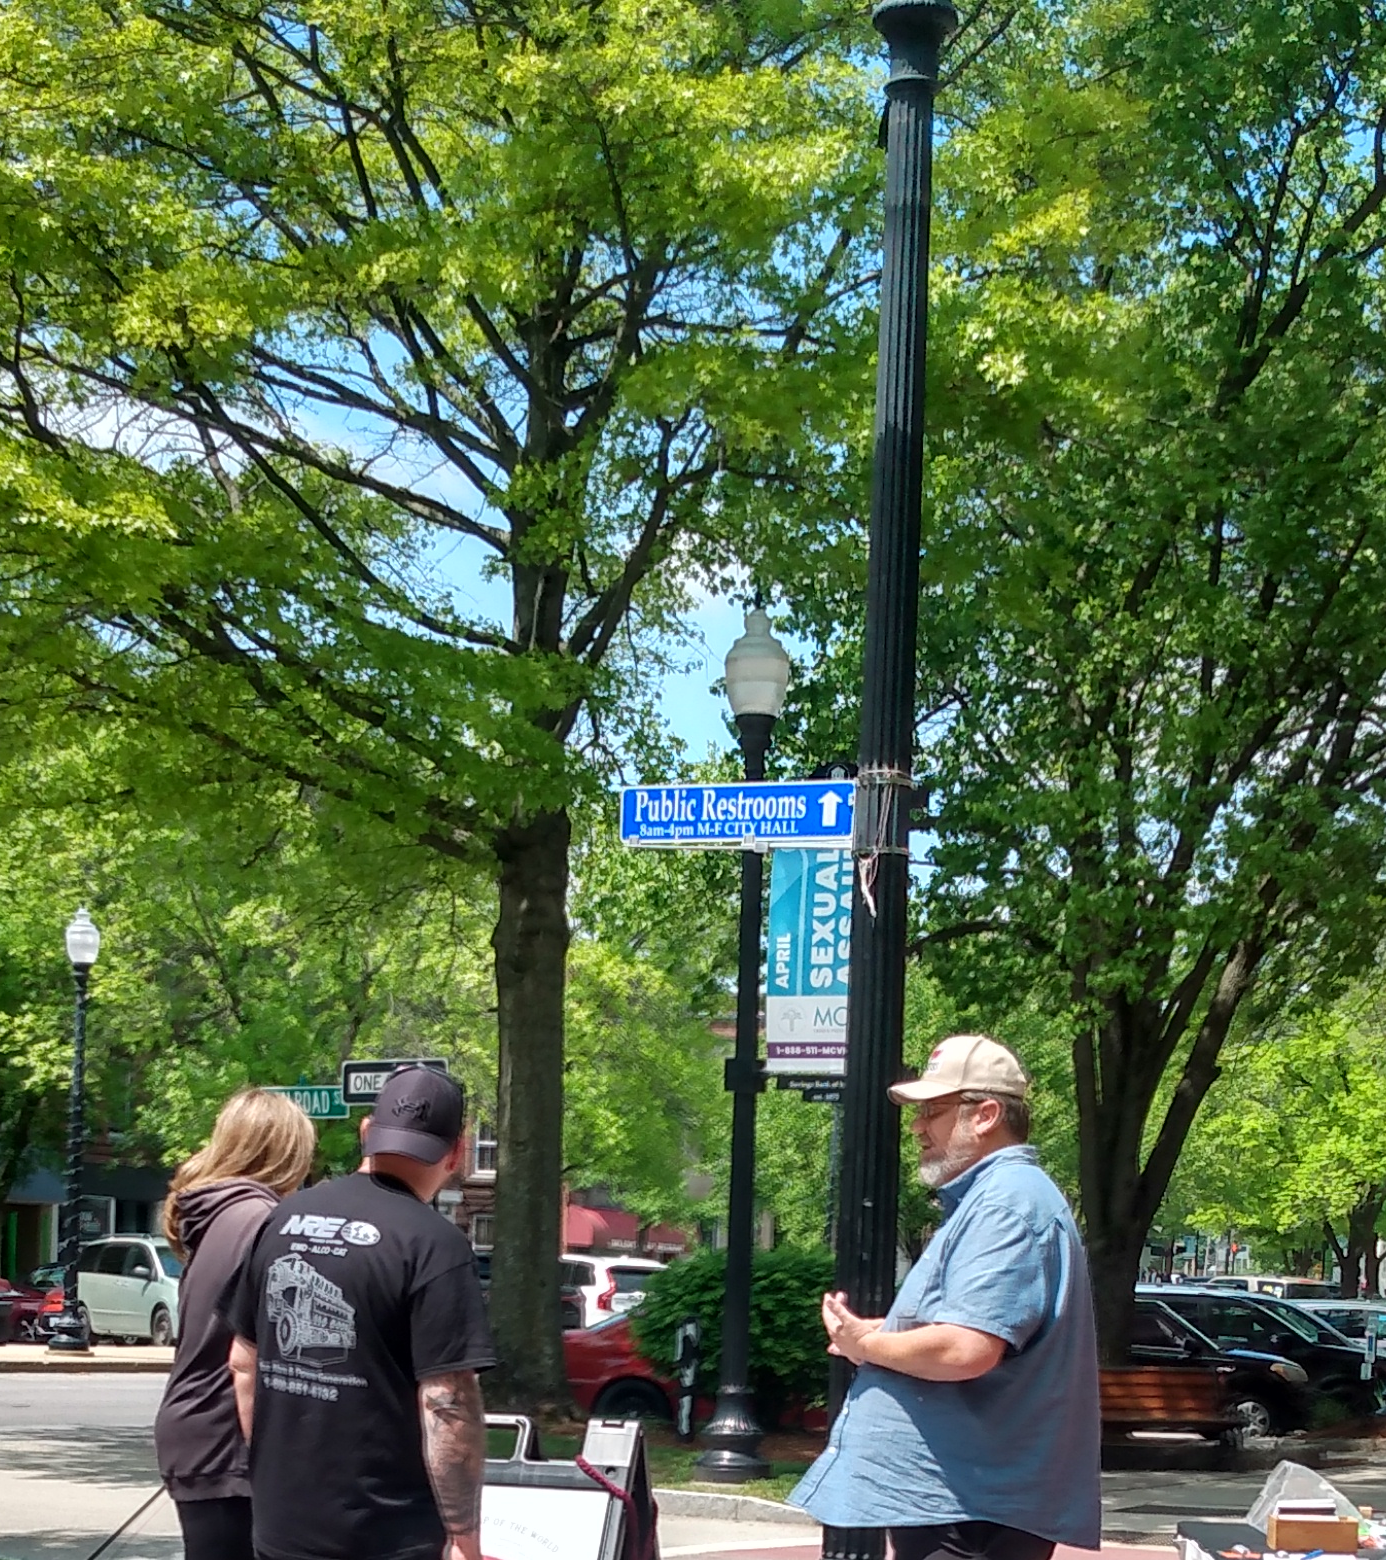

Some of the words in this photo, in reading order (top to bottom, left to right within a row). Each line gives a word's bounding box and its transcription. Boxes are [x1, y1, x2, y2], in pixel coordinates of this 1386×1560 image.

[634, 789, 697, 823] Public
[700, 787, 807, 821] Restrooms
[639, 823, 694, 839] 8am-4pm
[696, 822, 722, 836] M-F
[724, 821, 757, 836] CITY
[760, 820, 799, 835] HALL
[809, 849, 840, 989] SEXUAL
[775, 932, 792, 989] APRIL
[353, 1074, 382, 1092] ONE
[279, 1214, 347, 1239] NRE
[509, 1521, 529, 1535] THE
[530, 1530, 560, 1553] WORLD
